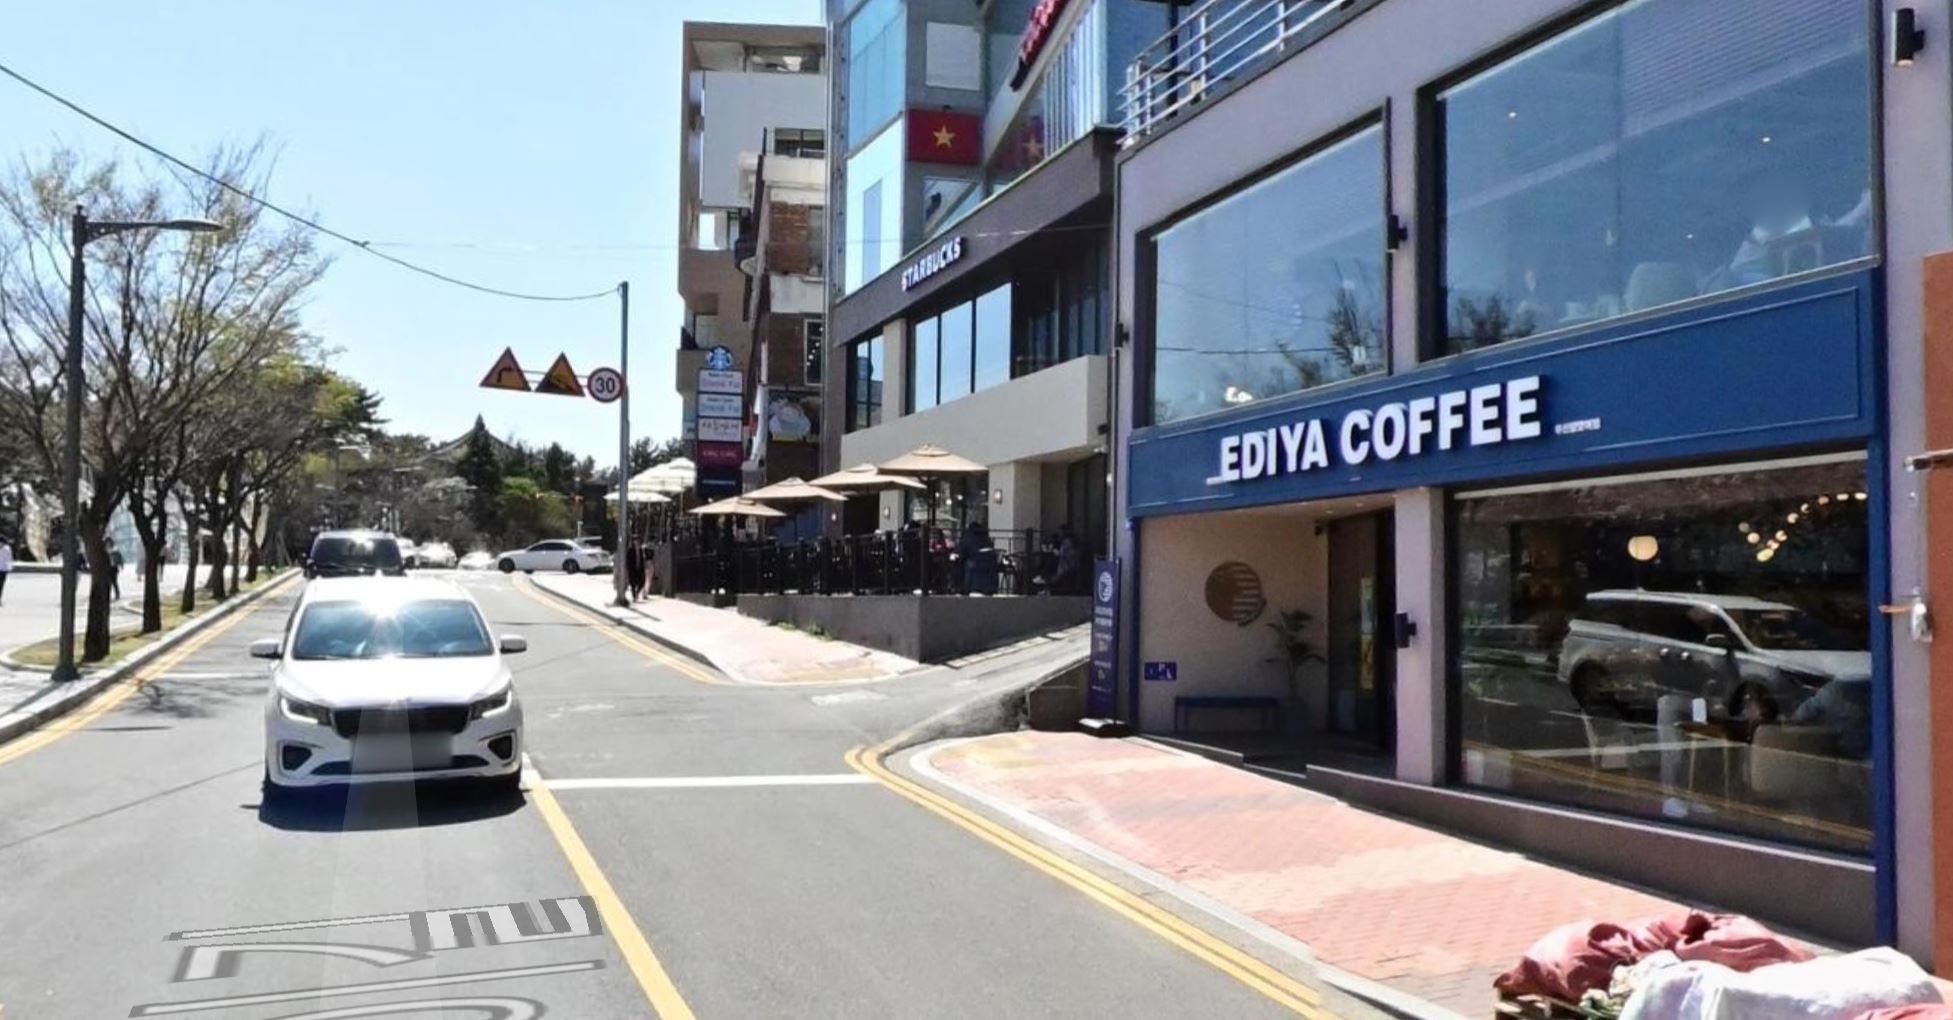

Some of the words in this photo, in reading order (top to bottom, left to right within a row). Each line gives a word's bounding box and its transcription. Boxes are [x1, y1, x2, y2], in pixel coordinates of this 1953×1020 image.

[901, 236, 961, 292] STARBUCKS
[595, 377, 616, 395] 30
[1206, 418, 1328, 486] EDIYA
[1340, 375, 1542, 466] COFFEE
